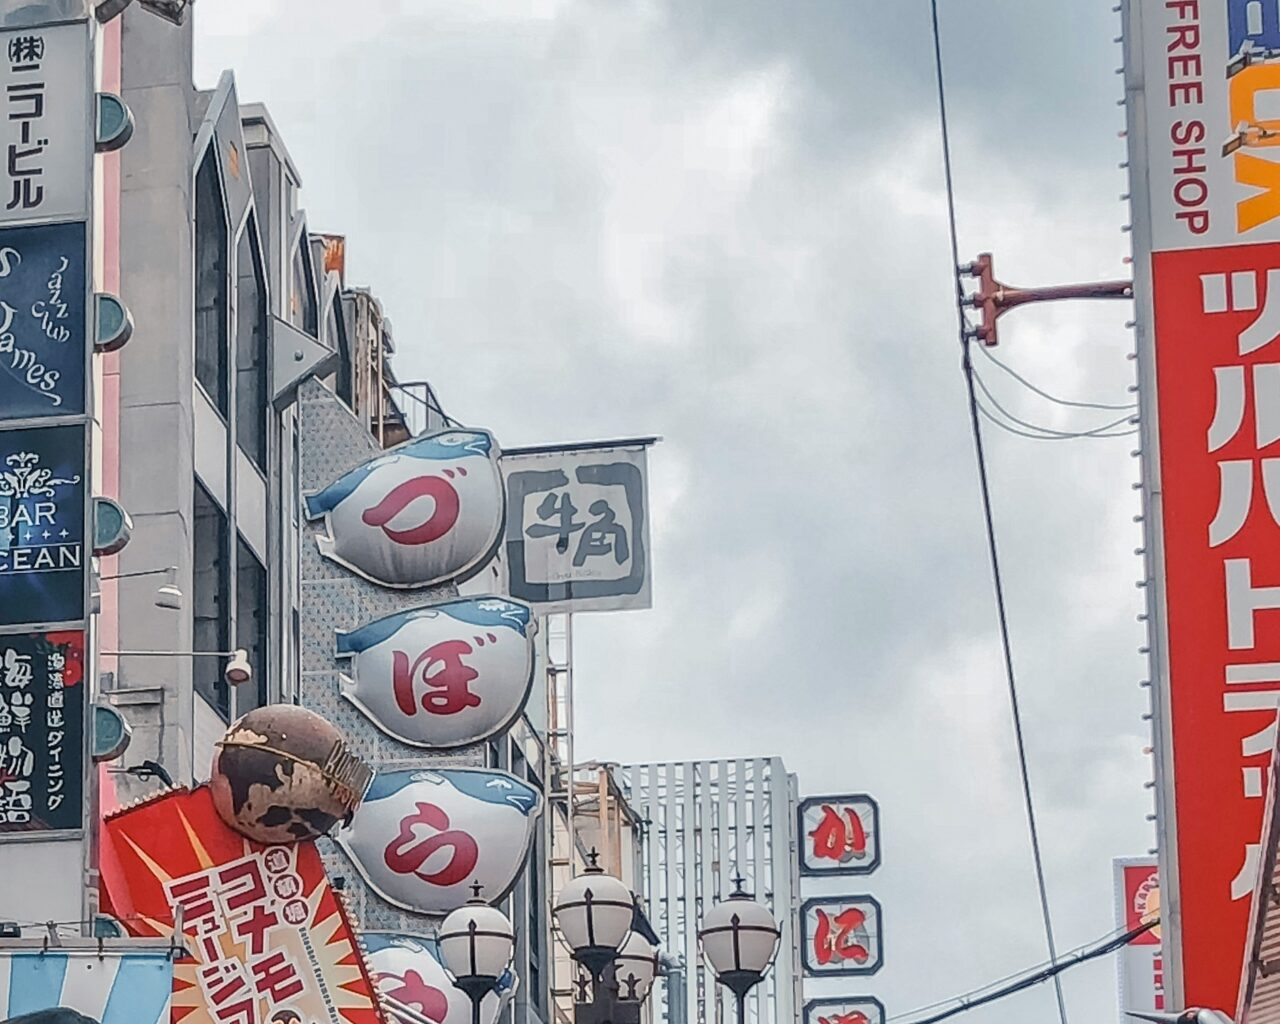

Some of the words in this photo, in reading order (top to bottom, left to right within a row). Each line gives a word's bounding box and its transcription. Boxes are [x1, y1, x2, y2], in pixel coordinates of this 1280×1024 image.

[1166, 0, 1203, 107] FREE
[1170, 119, 1210, 235] SHOP
[524, 491, 630, 568] 牛角
